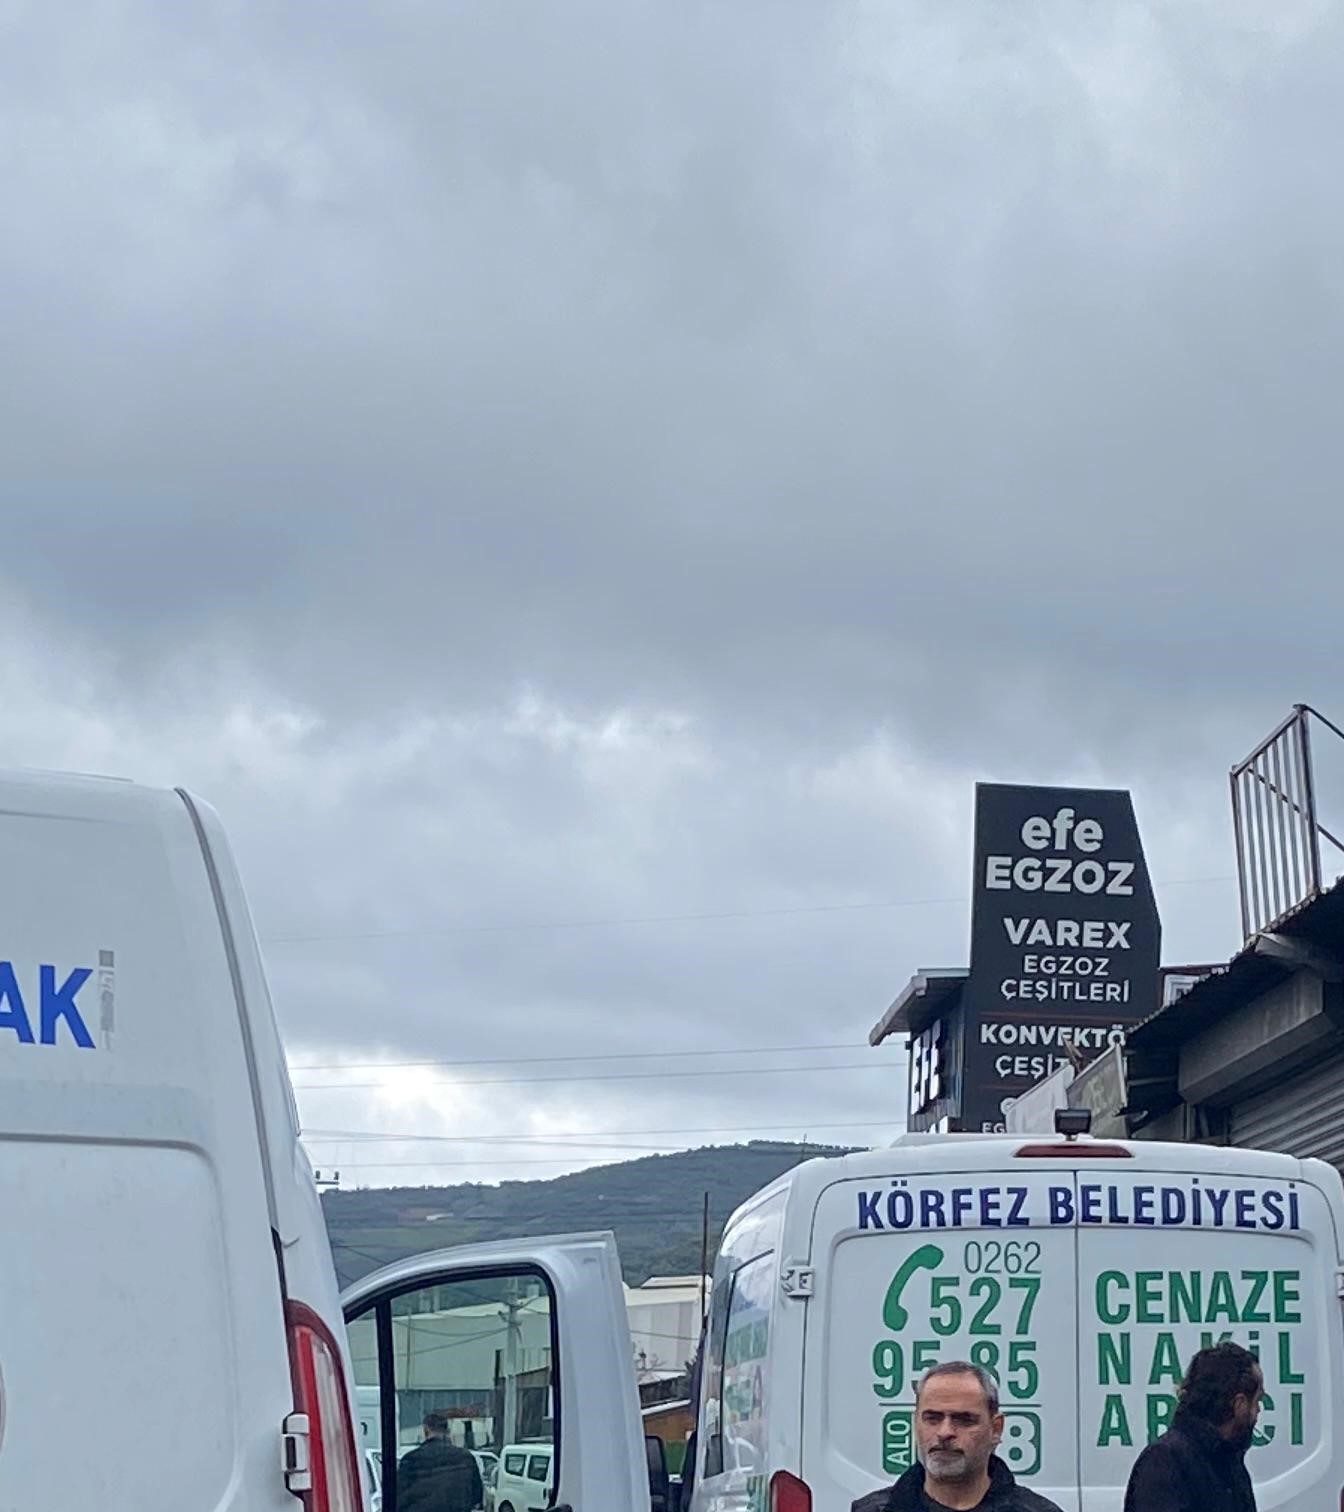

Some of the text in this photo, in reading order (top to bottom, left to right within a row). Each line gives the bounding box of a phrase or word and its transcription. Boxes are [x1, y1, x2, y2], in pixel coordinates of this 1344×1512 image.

[1021, 807, 1104, 852] efe
[985, 856, 1135, 896] EGZOZ
[1003, 917, 1132, 949] VAREX
[1024, 955, 1110, 976] EGZOZ
[1001, 978, 1130, 1003] ÇEŞİTLERİ
[980, 1023, 1126, 1048] KONVEKTÖ
[857, 1177, 1300, 1230] KÖRFEZ BELEDİYESİ
[964, 1240, 1042, 1274] 0262
[929, 1276, 1041, 1336] 527
[1095, 1270, 1302, 1325] CENAZE
[1097, 1330, 1305, 1385] NAL
[886, 1419, 911, 1467] ALO
